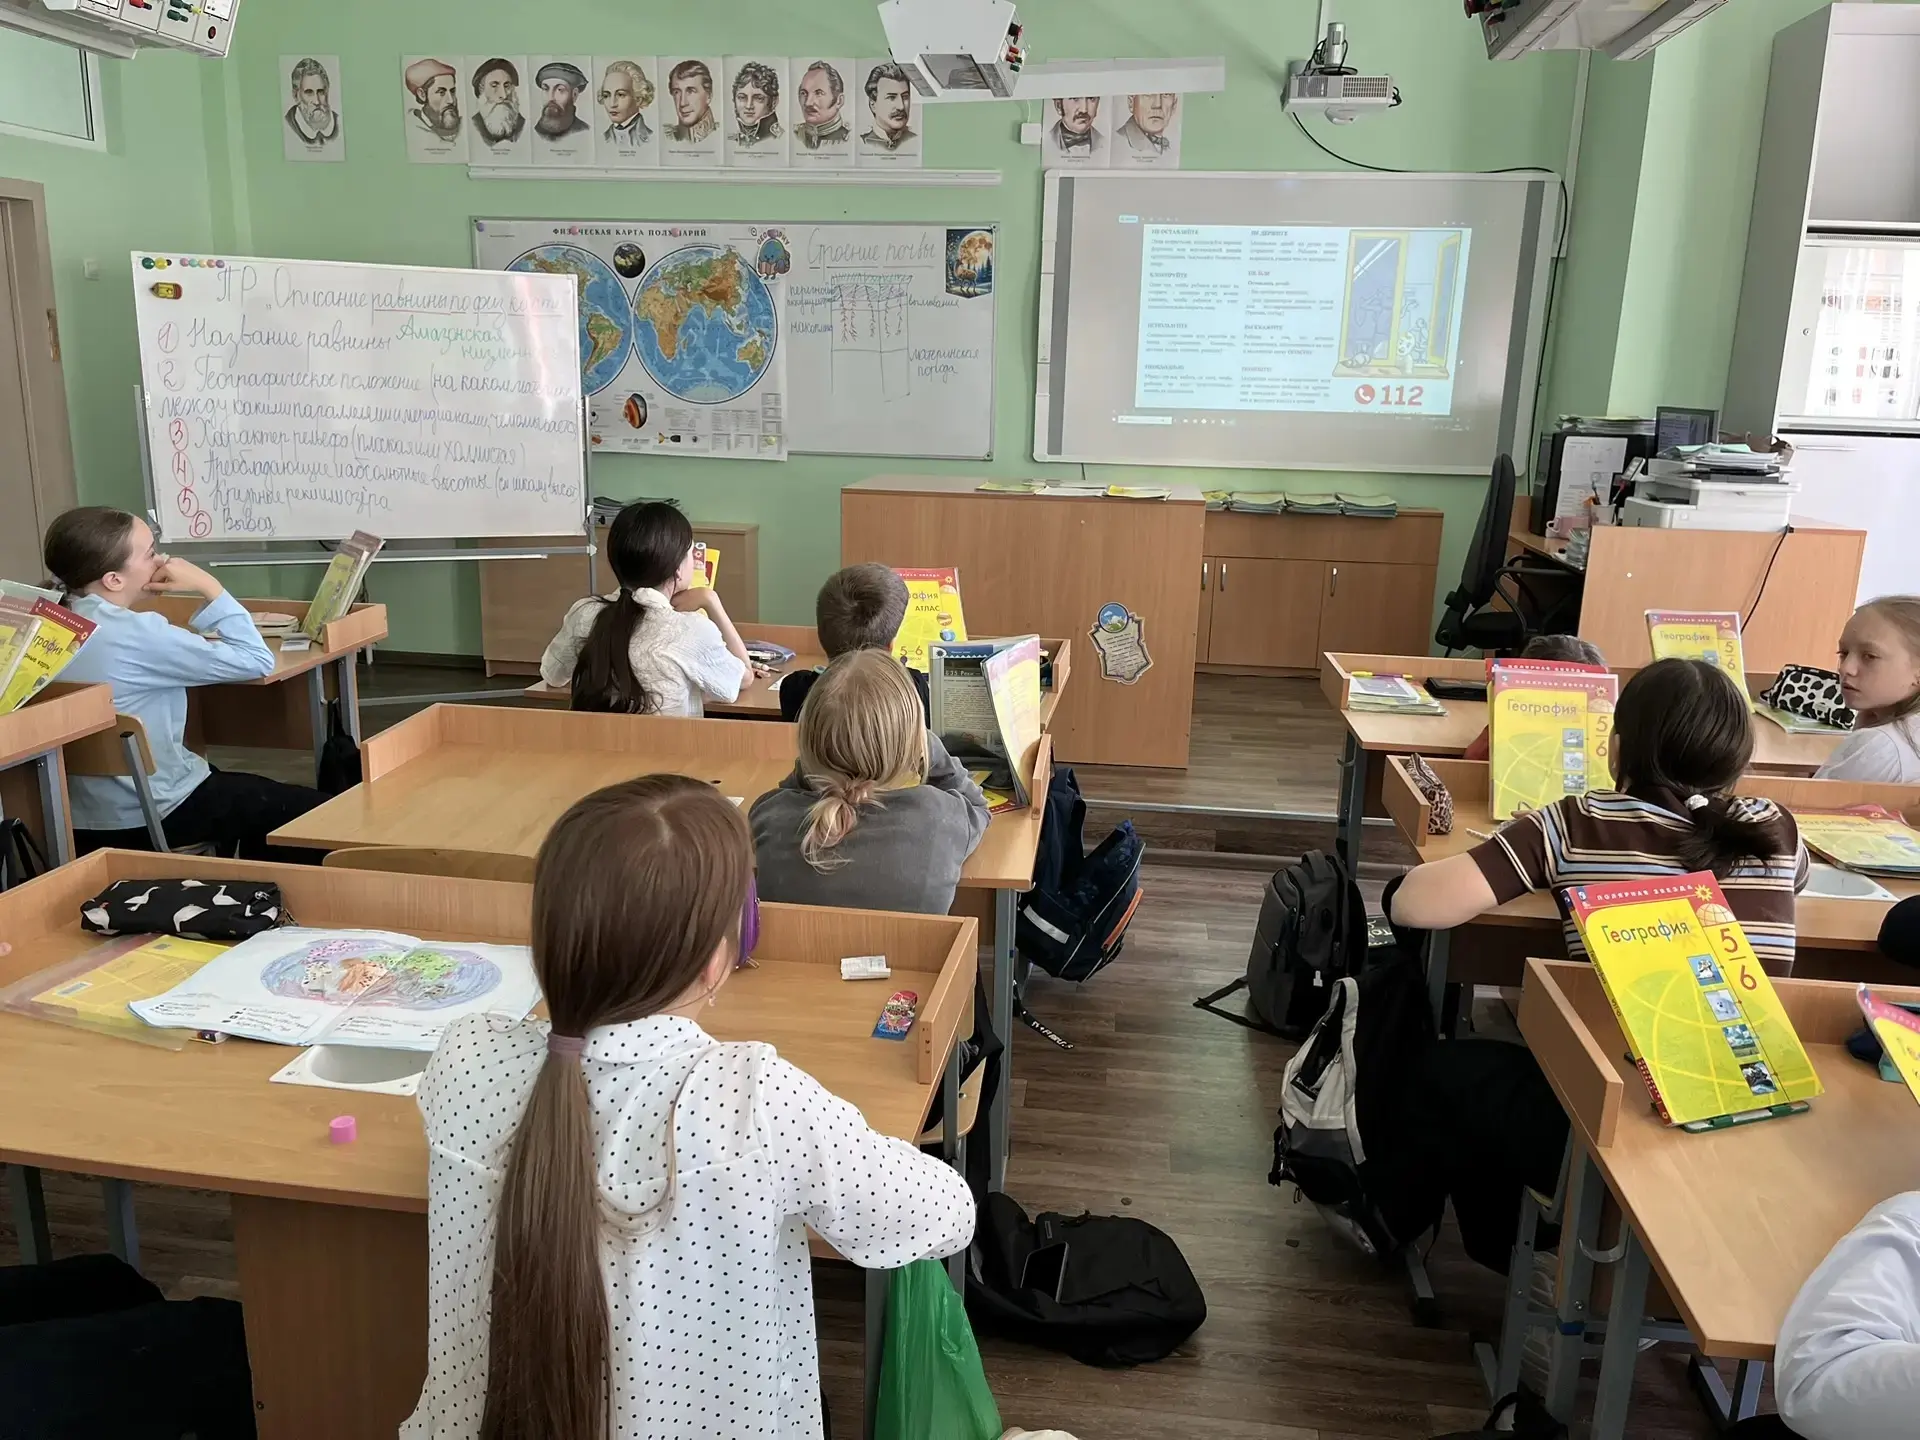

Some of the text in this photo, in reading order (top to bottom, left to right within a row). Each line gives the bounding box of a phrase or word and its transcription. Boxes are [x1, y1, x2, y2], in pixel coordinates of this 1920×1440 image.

[552, 228, 611, 236] ФИЗЧЕСКАЯ
[648, 229, 707, 237] ПОЛУАРИЙ
[371, 277, 447, 326] равнины
[187, 315, 302, 368] Название
[307, 320, 391, 371] равнины
[195, 354, 337, 399] Географическое
[1381, 385, 1424, 405] 112
[194, 416, 289, 460] Характер
[222, 507, 276, 536] Вывод
[1660, 630, 1710, 644] География
[1725, 641, 1734, 653] 5
[1727, 658, 1736, 670] 6
[1507, 698, 1577, 717] География
[1596, 716, 1608, 733] 5
[1595, 740, 1607, 757] 6
[1596, 884, 1694, 901] ПОЛЯРНАЯ ЗВЕЗДА
[1601, 918, 1690, 945] География
[1720, 928, 1739, 953] 5
[1739, 965, 1757, 990] 6
